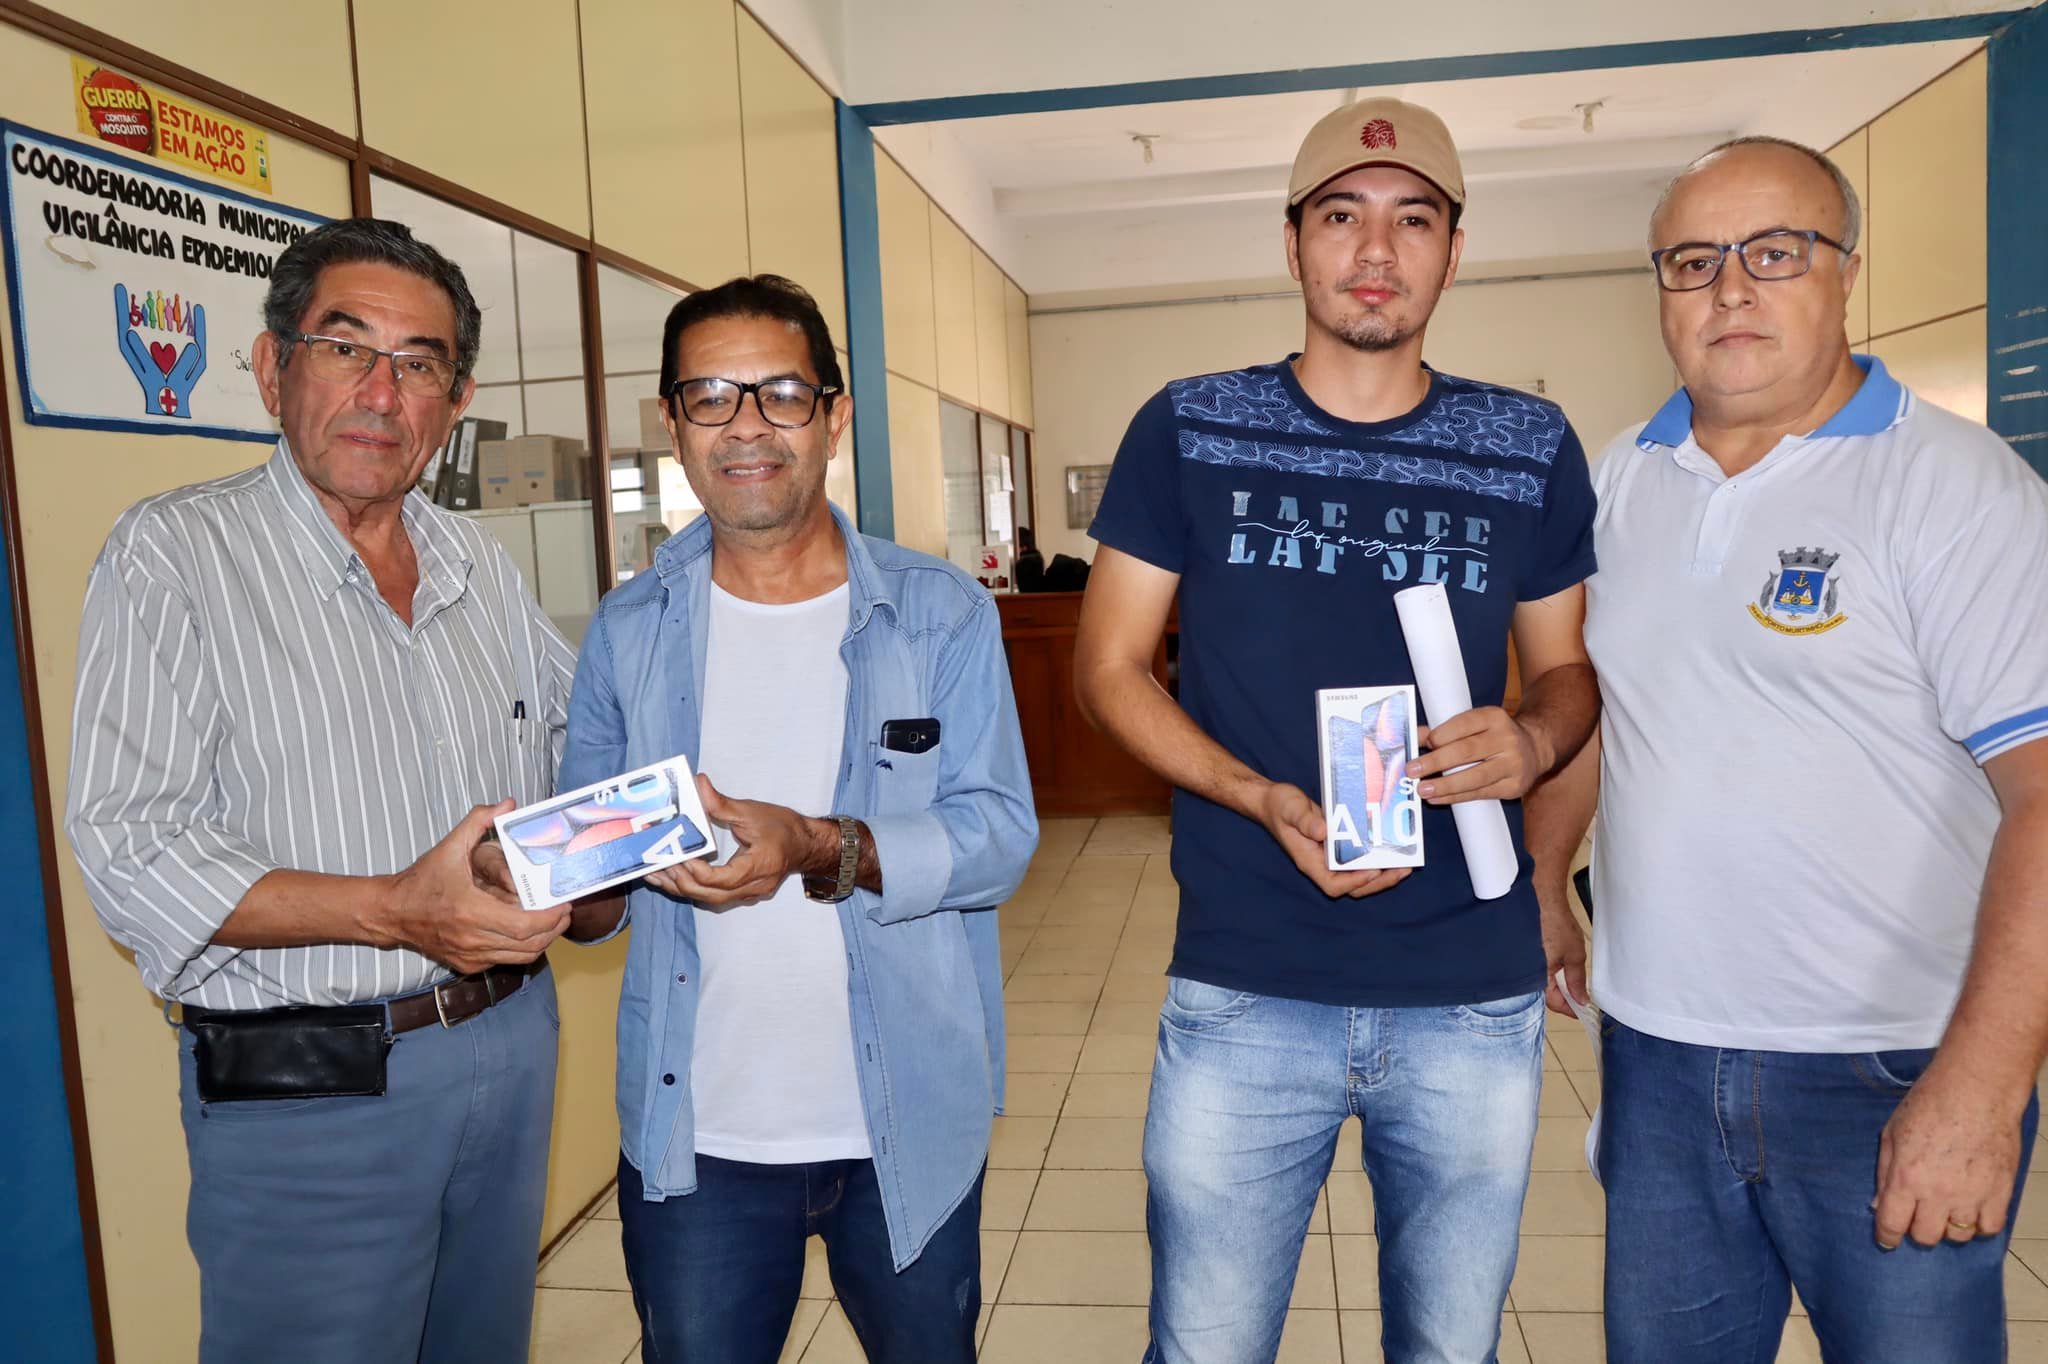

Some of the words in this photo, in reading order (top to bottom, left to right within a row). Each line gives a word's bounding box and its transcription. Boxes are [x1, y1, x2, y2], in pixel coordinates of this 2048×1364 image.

[82, 86, 149, 110] GUERRA
[100, 122, 148, 136] MOSQUITO
[104, 113, 132, 123] CONTRA
[157, 100, 246, 151] ESTAMOS
[159, 128, 190, 158] EM
[194, 143, 246, 175] AÇÃO
[11, 143, 206, 226] COORDENADORIA
[43, 200, 175, 260] VIGILÂNCIA
[1338, 536, 1440, 558] original
